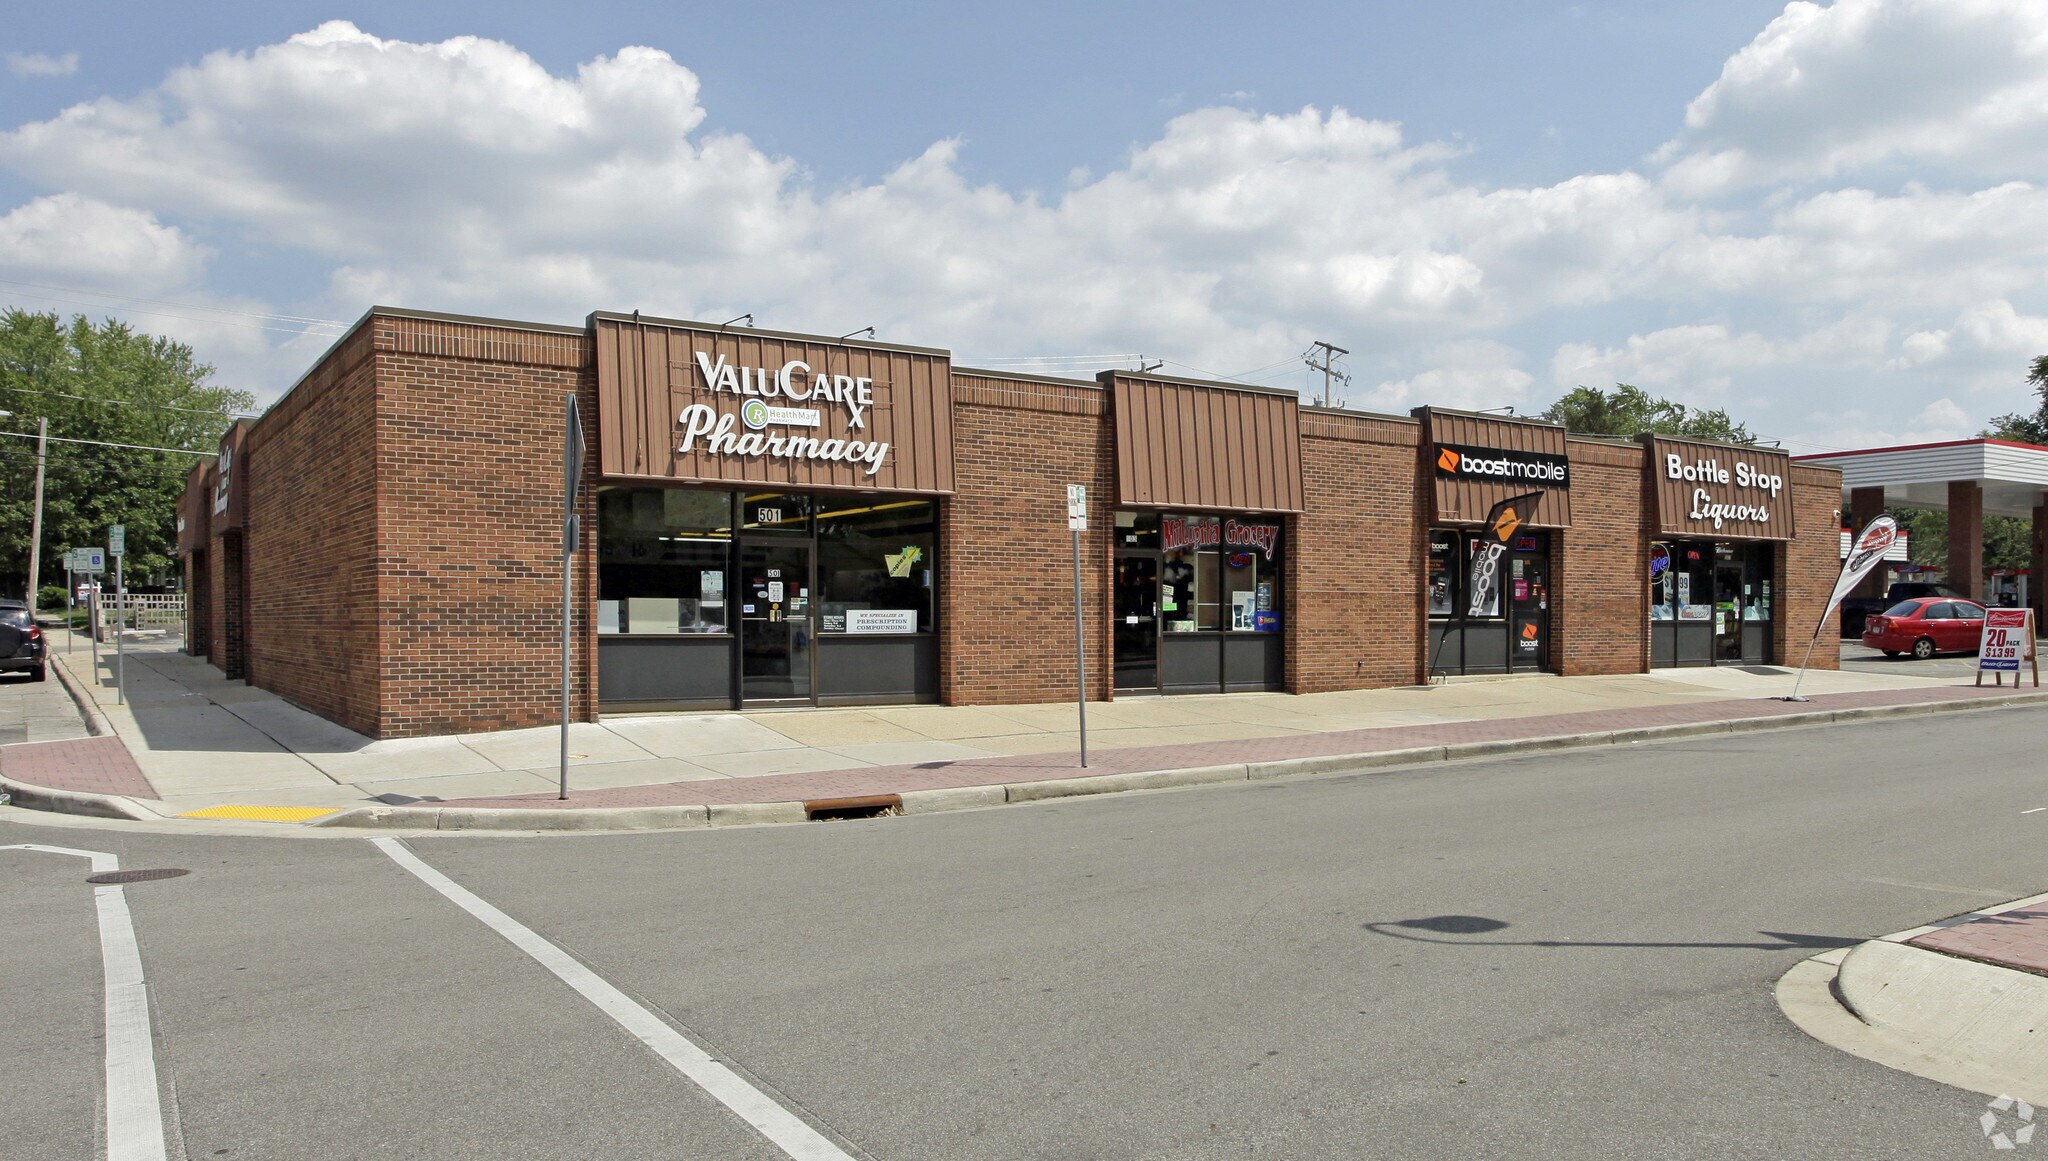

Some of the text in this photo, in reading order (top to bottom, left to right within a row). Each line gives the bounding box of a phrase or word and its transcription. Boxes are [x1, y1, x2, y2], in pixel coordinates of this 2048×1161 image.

[679, 404, 889, 475] Pharmacy
[1668, 454, 1782, 498] Bottle Stop
[759, 508, 780, 522] 501
[1690, 488, 1769, 529] Liquors
[1225, 520, 1278, 560] Grocery
[1687, 550, 1700, 559] OPEN
[1468, 544, 1507, 617] boost
[1472, 541, 1490, 581] mobile
[1986, 629, 2007, 647] 20
